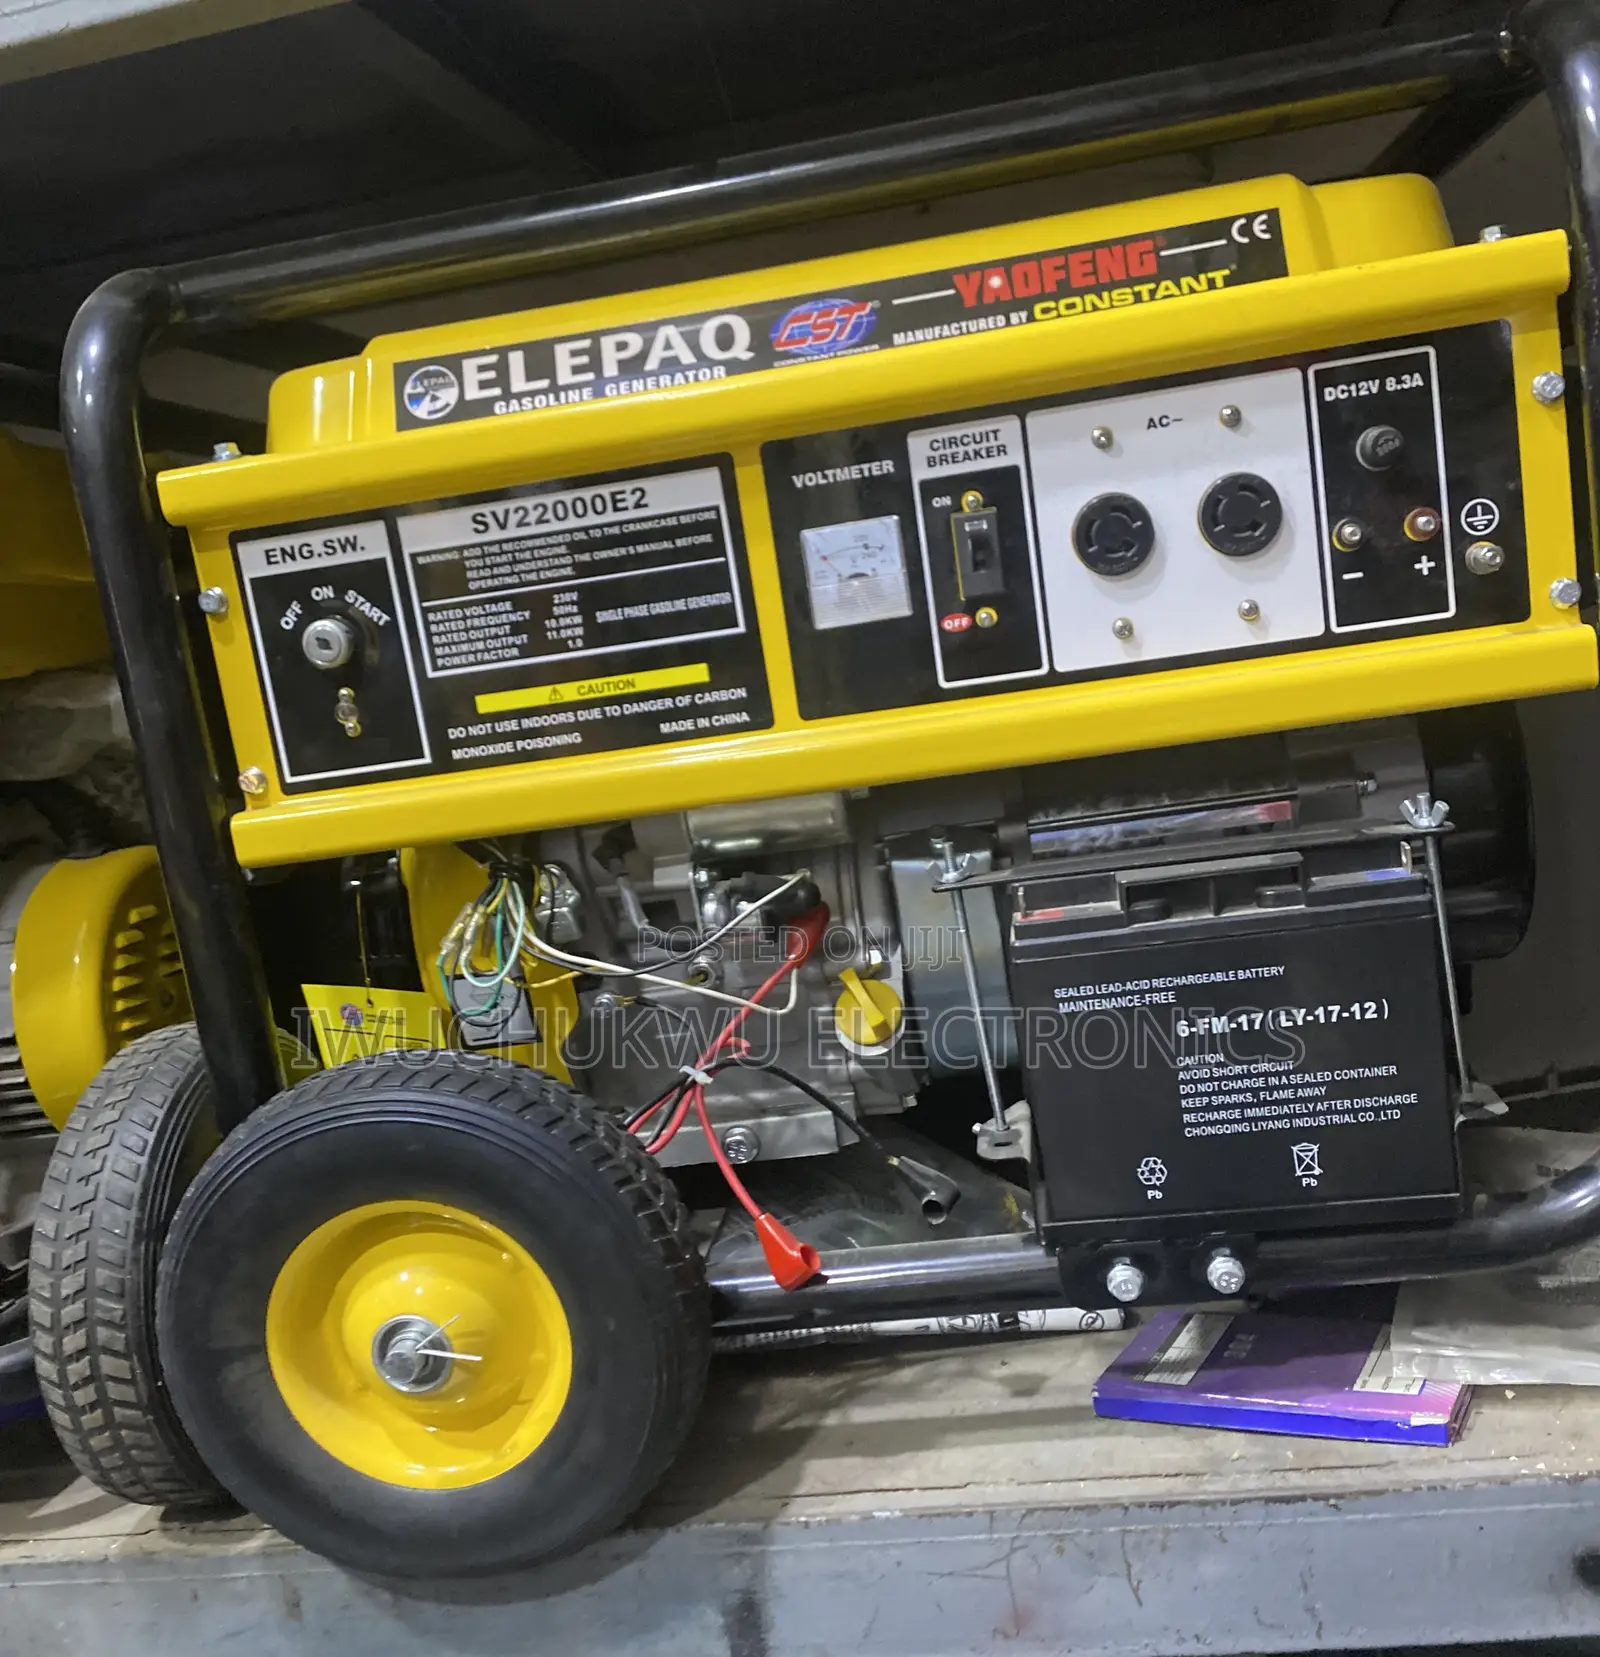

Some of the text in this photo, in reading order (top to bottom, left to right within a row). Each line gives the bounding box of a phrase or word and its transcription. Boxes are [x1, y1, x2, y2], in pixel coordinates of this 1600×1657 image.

[953, 240, 1159, 307] YAOFENG
[893, 267, 1231, 346] MANUFACTURED BY CONSTANT
[461, 314, 755, 401] ELEPAQ
[493, 365, 727, 416] GASOLINE GENERATOR
[1323, 371, 1424, 402] DC12V 8.3A
[929, 428, 1002, 452] CIRCUIT
[926, 443, 1008, 468] BREAKER
[791, 459, 895, 488] VOLTMETER
[471, 486, 649, 534] SV22000E2
[931, 495, 952, 508] ON
[264, 534, 366, 566] ENG.SW.
[311, 584, 335, 602] ON
[467, 574, 519, 590] OPERATING
[520, 572, 538, 583] THE
[279, 600, 303, 631] OFF
[344, 588, 391, 627] START
[427, 601, 513, 622] RATED VOLTAGE
[429, 611, 531, 634] RATED FREQUENCY
[943, 616, 969, 630] OFF
[432, 625, 511, 645] RATED OUTPUT
[434, 634, 529, 656] MAXIMUM OUTPUT
[436, 647, 520, 668] POWER FACTOR
[576, 678, 636, 697] CAUTION
[447, 687, 747, 740] DO NOT USE INDOORS DUE TO DANGER OF CARBON
[659, 711, 750, 734] MADE IN CHINA
[451, 732, 582, 760] MONOXIDE POISONING
[1053, 965, 1285, 999] SEALED LEAD-ACID RECHARGEABLE BATTERY
[1058, 991, 1176, 1014] MAINTENANCE-FREE
[1176, 1053, 1224, 1067] CAUTION
[1178, 1060, 1294, 1081] AVOID SHORT CIRCUIT
[1179, 1065, 1398, 1095] DO NOT CHARGE IN A SEALED CONTAINER
[1181, 1086, 1328, 1109] KEEP SPARKS, FLAME AWAY
[1183, 1093, 1419, 1124] RECHARGE IMMEDIATELY AFTER DISCHARGE
[1184, 1121, 1250, 1138] CHONGQING
[1251, 1118, 1290, 1132] LIYANG
[1292, 1112, 1357, 1129] INDUSTRIAL
[1147, 1188, 1163, 1200] Pb
[1301, 1177, 1318, 1188] Pb
